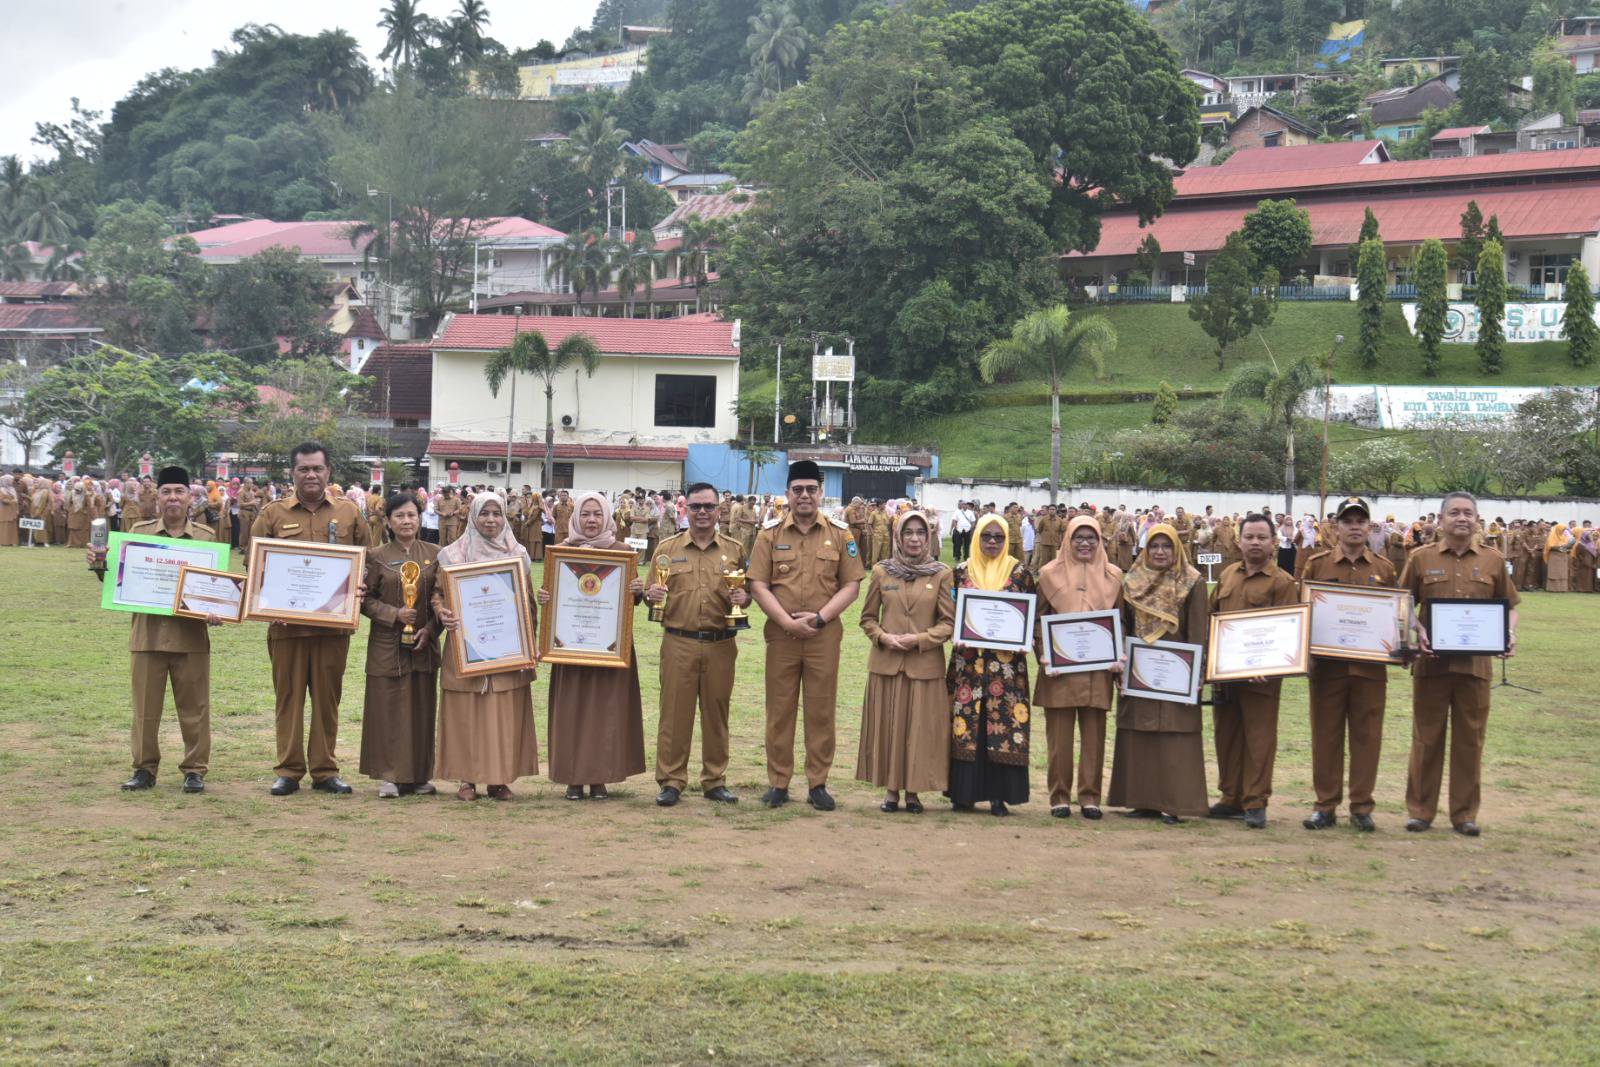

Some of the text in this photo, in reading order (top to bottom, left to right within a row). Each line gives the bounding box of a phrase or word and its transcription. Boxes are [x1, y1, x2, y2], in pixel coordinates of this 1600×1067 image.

[1427, 391, 1498, 401] SAWAHLUNTO
[1403, 401, 1428, 411] KOTA
[1432, 402, 1470, 412] WISATA
[844, 454, 907, 466] LAPANGAN OMBILIN
[850, 464, 901, 473] SAWAHLUNTO
